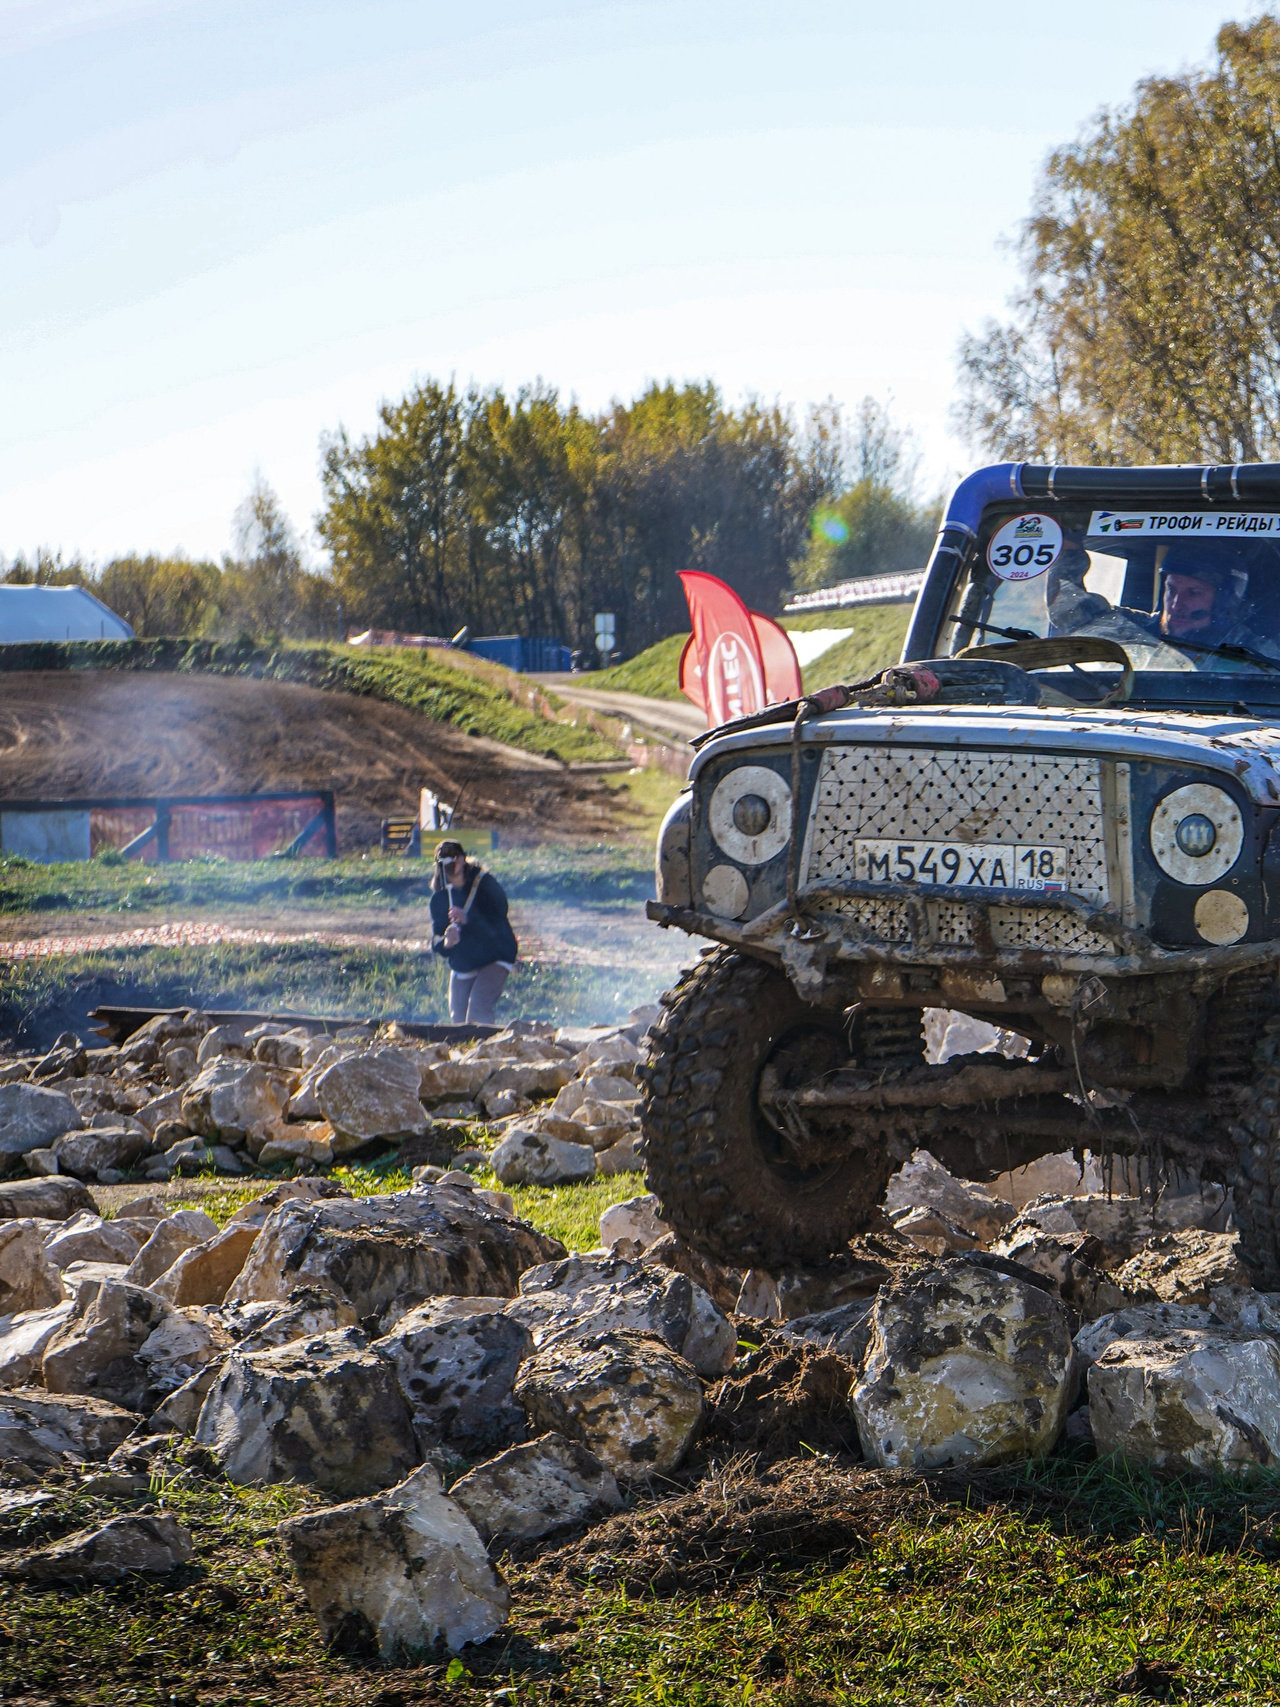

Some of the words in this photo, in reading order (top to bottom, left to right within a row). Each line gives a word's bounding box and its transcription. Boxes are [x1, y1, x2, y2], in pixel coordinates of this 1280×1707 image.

[1149, 515, 1203, 530] ТРОФИ
[1216, 514, 1272, 532] РЕЙДЫ
[992, 544, 1056, 566] 305
[1020, 849, 1055, 878] 18
[1017, 878, 1043, 890] RUS
